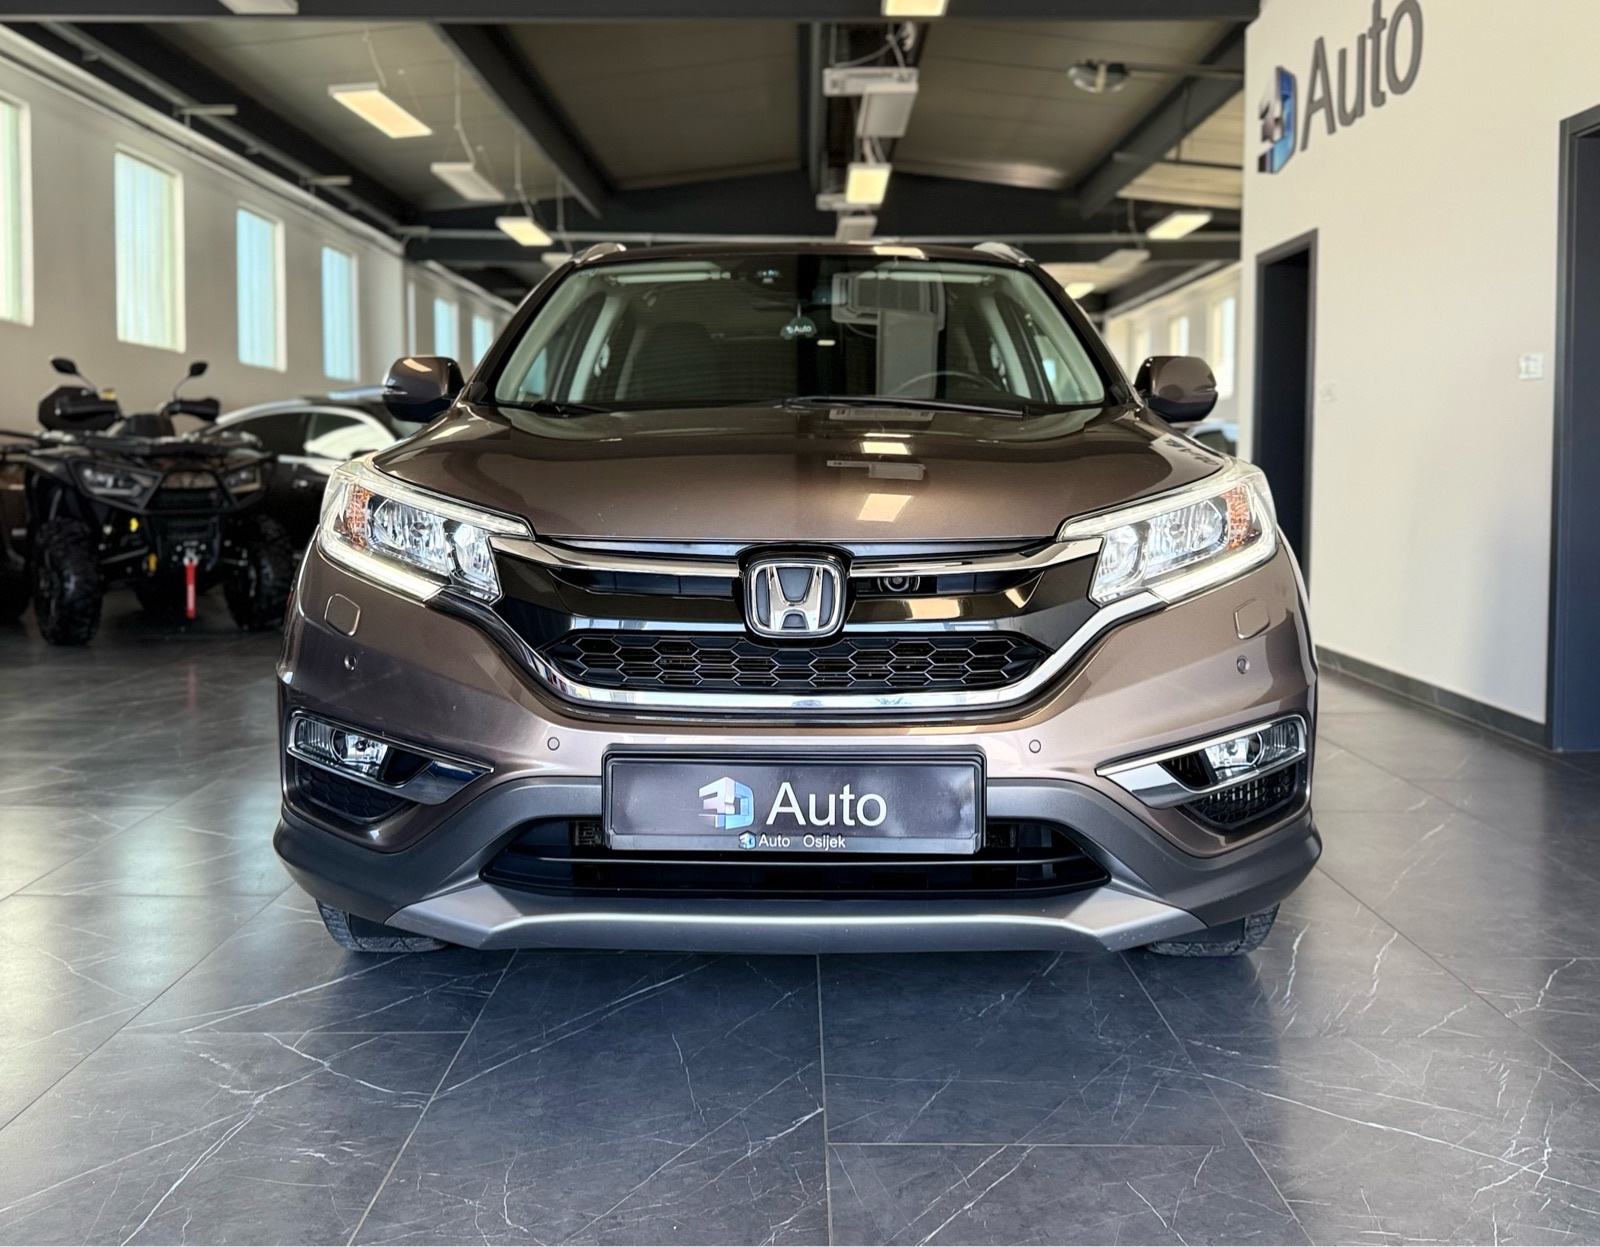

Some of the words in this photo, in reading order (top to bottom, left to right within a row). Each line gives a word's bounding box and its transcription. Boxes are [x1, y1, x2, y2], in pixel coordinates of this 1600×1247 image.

[1300, 0, 1423, 152] Auto
[765, 781, 888, 827] Auto
[759, 833, 791, 848] Auto
[803, 834, 846, 851] Osijek
